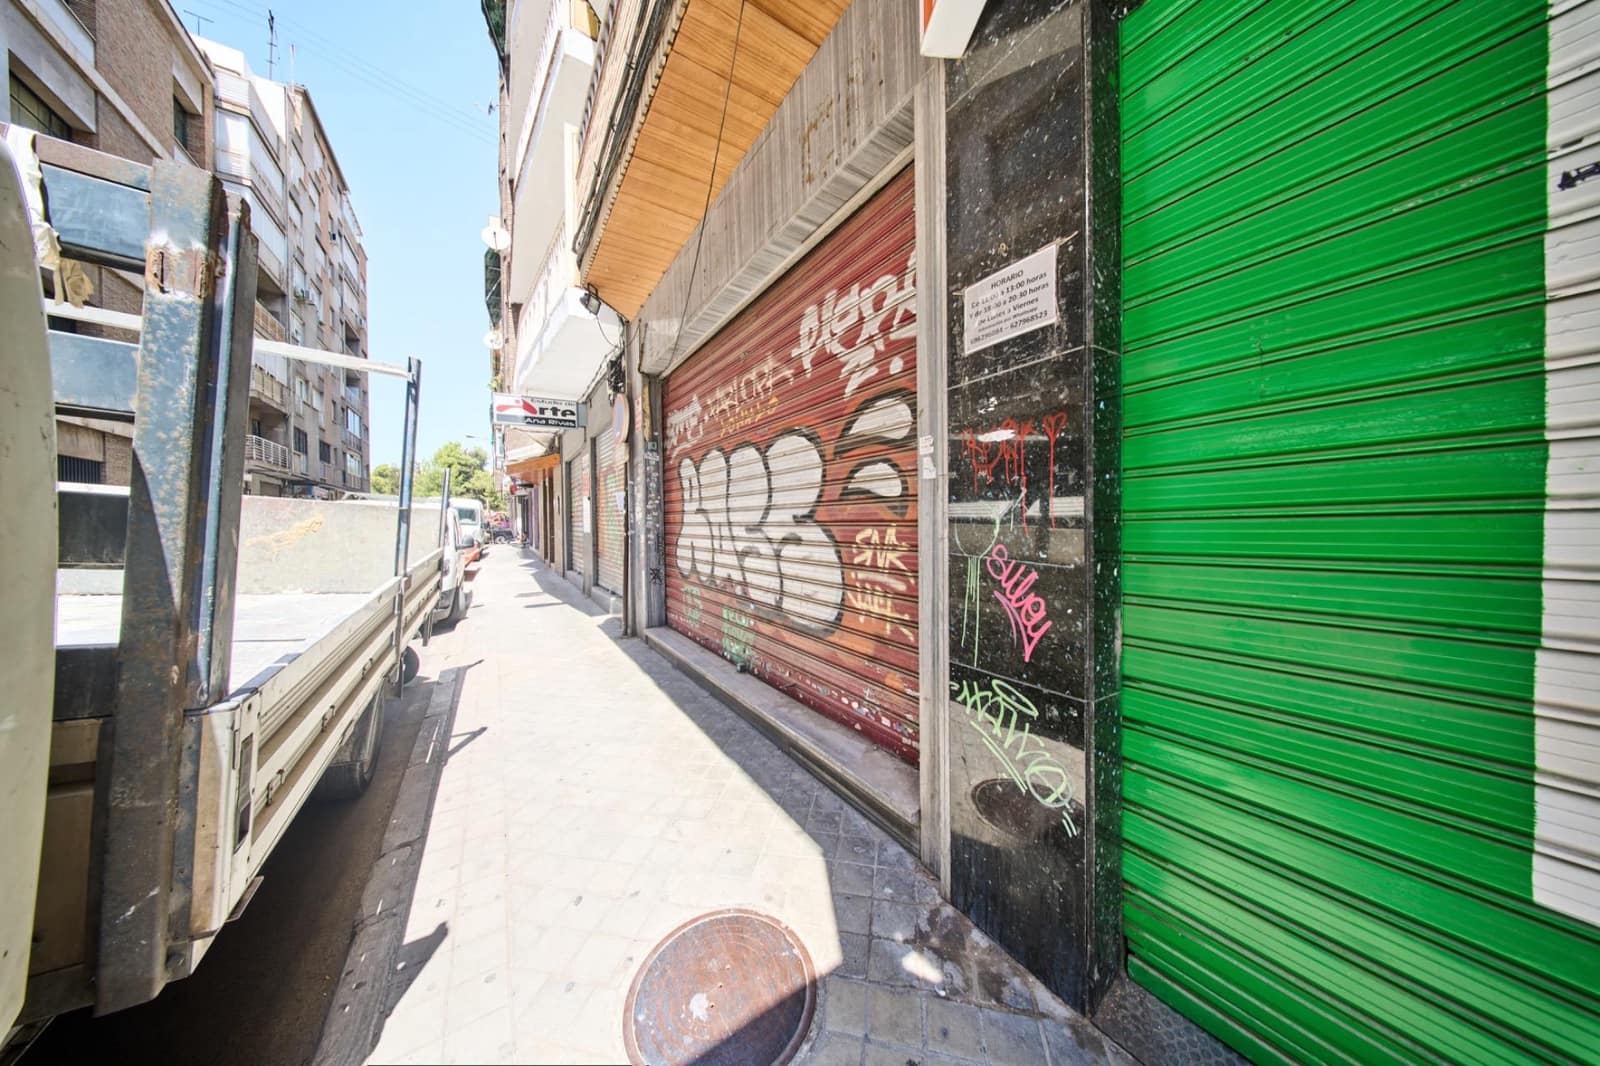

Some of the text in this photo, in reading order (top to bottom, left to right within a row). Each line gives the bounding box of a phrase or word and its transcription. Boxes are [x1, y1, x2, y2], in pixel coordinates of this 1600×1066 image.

[991, 270, 1023, 289] HORARIO
[1026, 272, 1046, 284] horas
[1029, 283, 1048, 294] horas
[1012, 297, 1038, 311] Viernes
[525, 417, 547, 425] Ana
